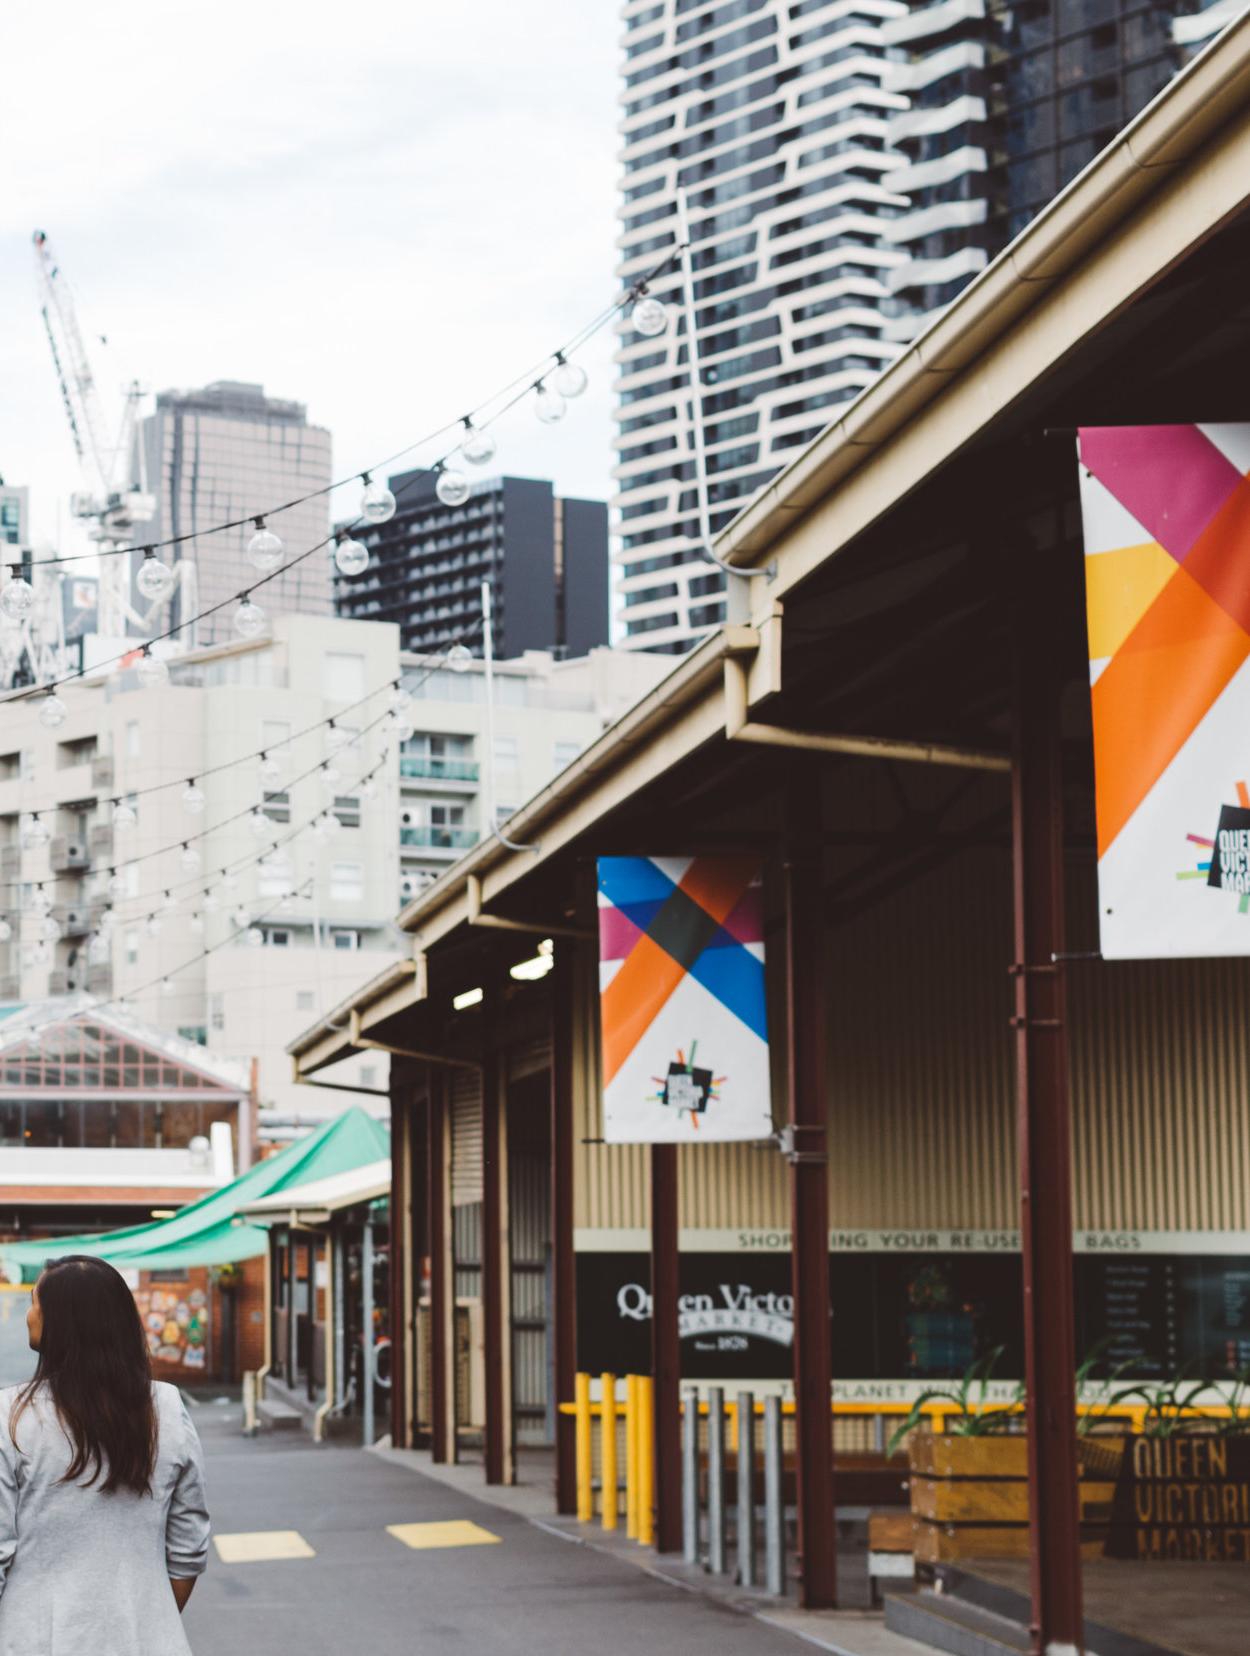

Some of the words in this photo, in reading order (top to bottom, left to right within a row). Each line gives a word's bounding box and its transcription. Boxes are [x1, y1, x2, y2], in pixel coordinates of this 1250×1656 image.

[1219, 829, 1250, 851] QUE
[880, 1233, 939, 1248] YOUR
[1086, 1235, 1141, 1249] BAGS
[617, 1283, 713, 1321] Qen
[832, 1384, 907, 1398] PLANET
[1133, 1437, 1227, 1478] QUEEN
